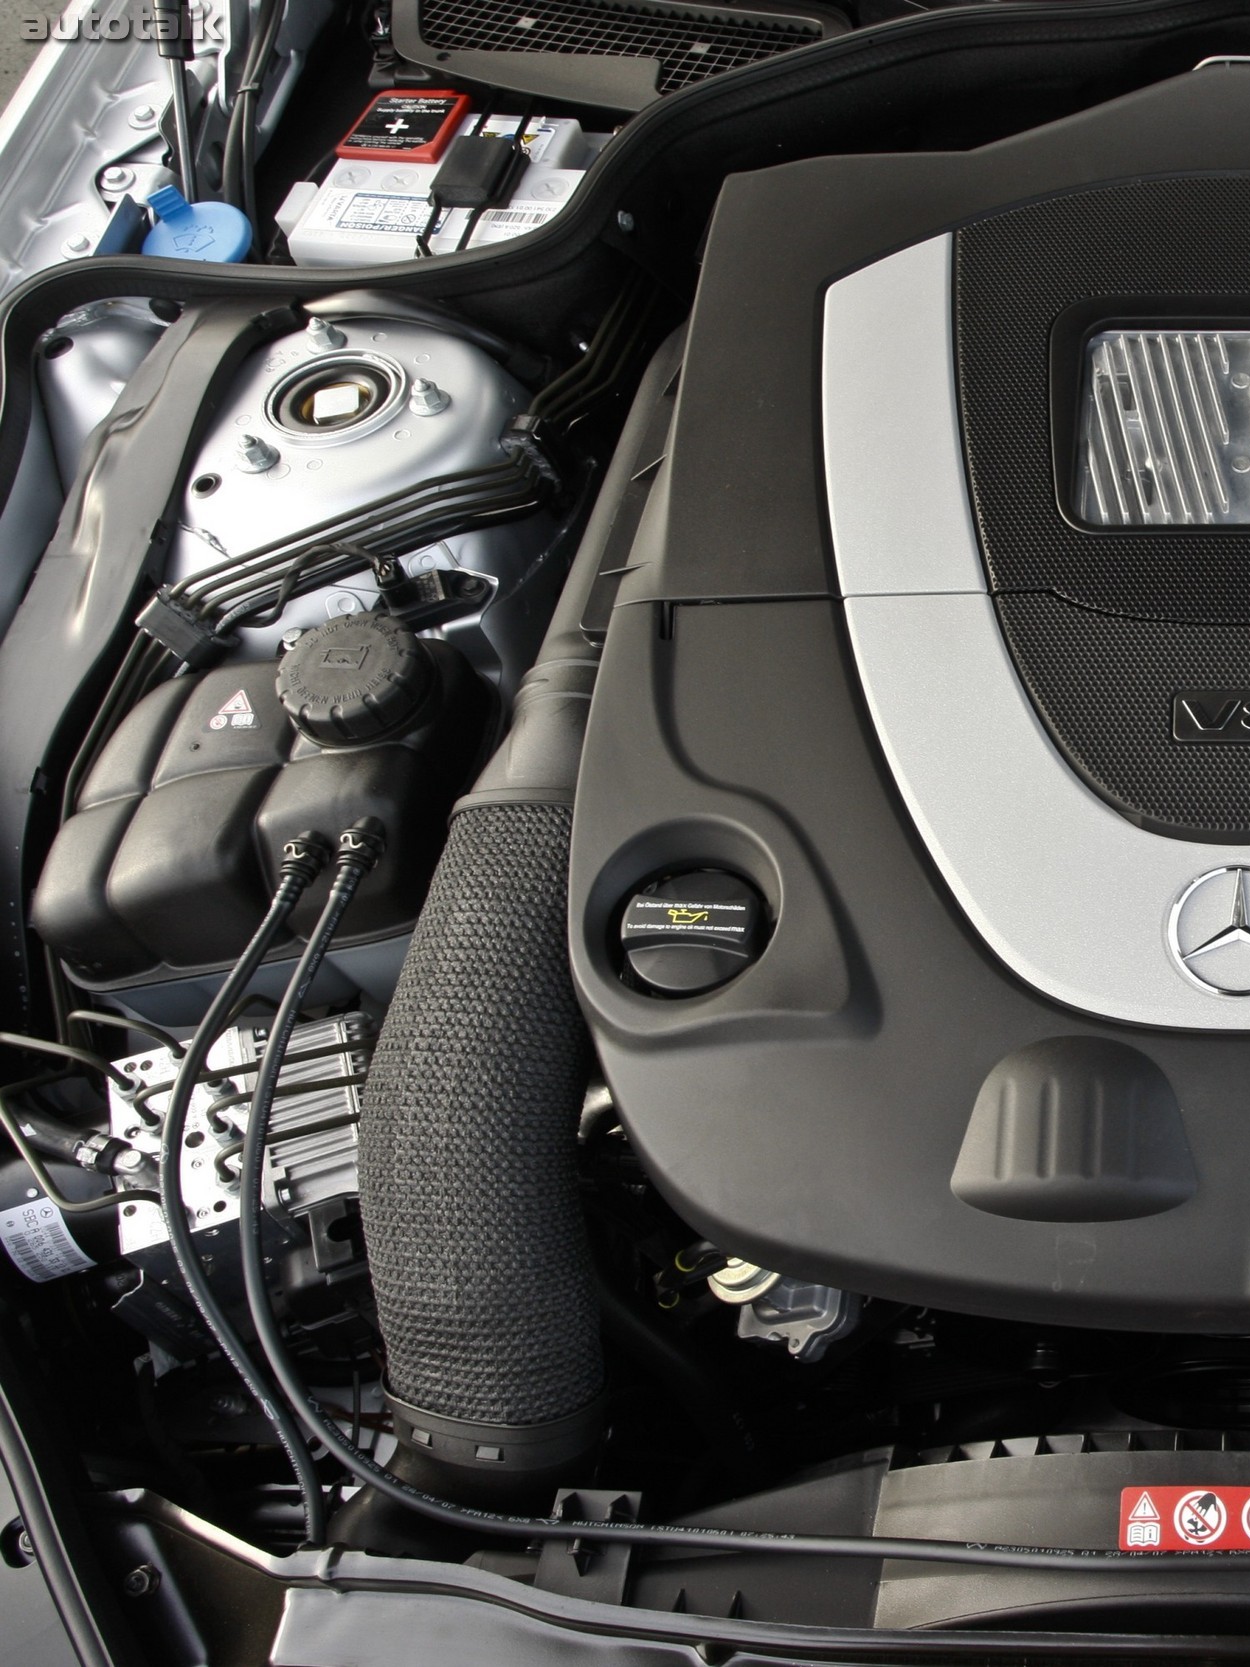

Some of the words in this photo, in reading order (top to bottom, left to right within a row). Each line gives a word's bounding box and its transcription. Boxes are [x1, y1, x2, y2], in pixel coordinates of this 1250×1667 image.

[23, 1208, 39, 1228] SBC
[276, 1429, 306, 1495] HUTCHINSON
[572, 1520, 644, 1530] HUTCHINSON
